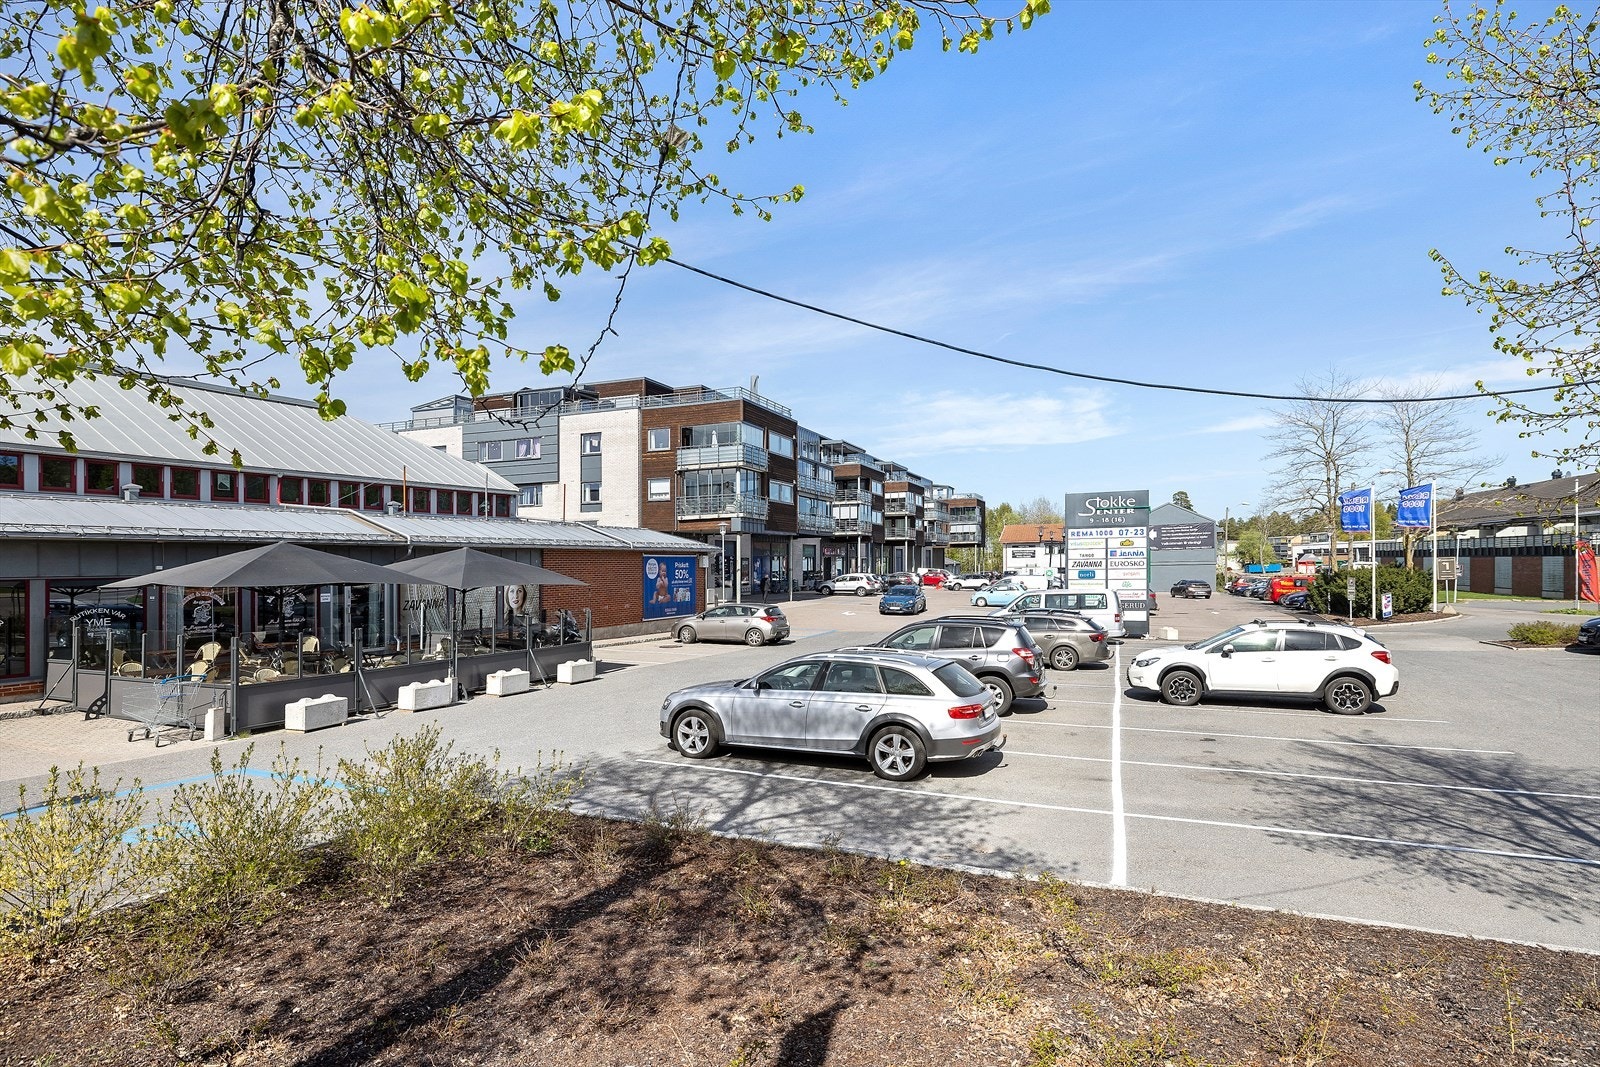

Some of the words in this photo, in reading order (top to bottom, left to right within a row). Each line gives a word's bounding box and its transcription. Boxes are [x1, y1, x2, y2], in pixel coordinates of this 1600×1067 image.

[1084, 495, 1136, 510] Stokke
[1111, 516, 1126, 524] (16)
[1118, 528, 1145, 536] 07-23
[1071, 560, 1103, 568] ZAVANNA
[674, 569, 689, 579] 50%
[86, 617, 111, 627] YME
